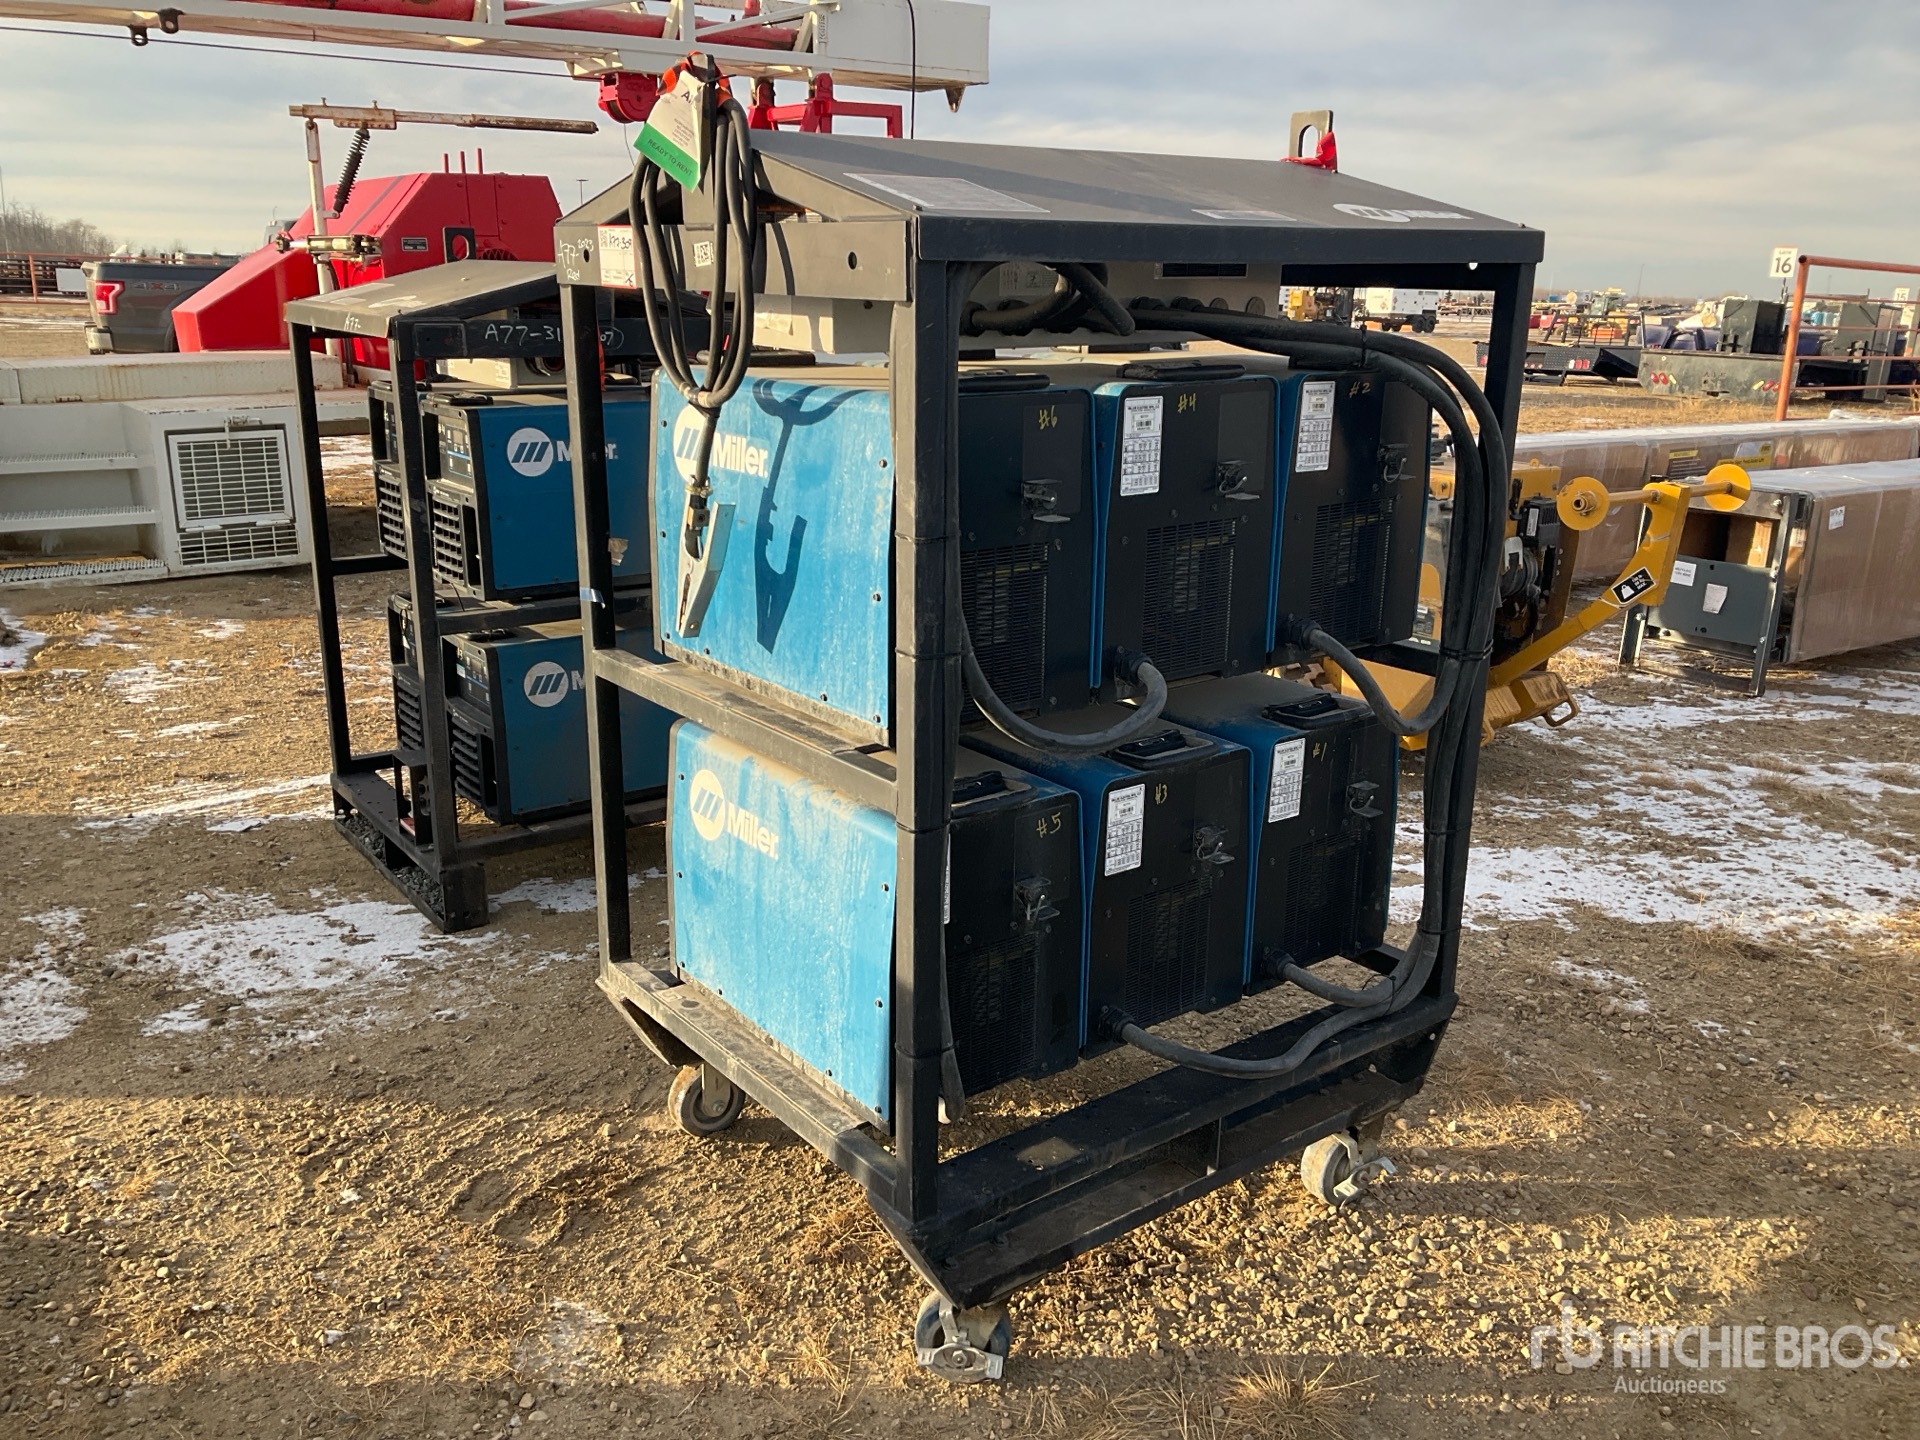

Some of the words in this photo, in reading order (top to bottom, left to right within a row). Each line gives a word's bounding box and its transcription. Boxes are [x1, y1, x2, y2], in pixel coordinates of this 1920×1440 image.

[647, 138, 669, 156] READY
[668, 154, 677, 165] TO
[676, 163, 693, 177] RENT
[577, 238, 594, 252] 2023
[1775, 256, 1792, 274] 16
[1177, 392, 1197, 414] #4
[1038, 404, 1058, 430] #6
[1035, 811, 1062, 839] #5
